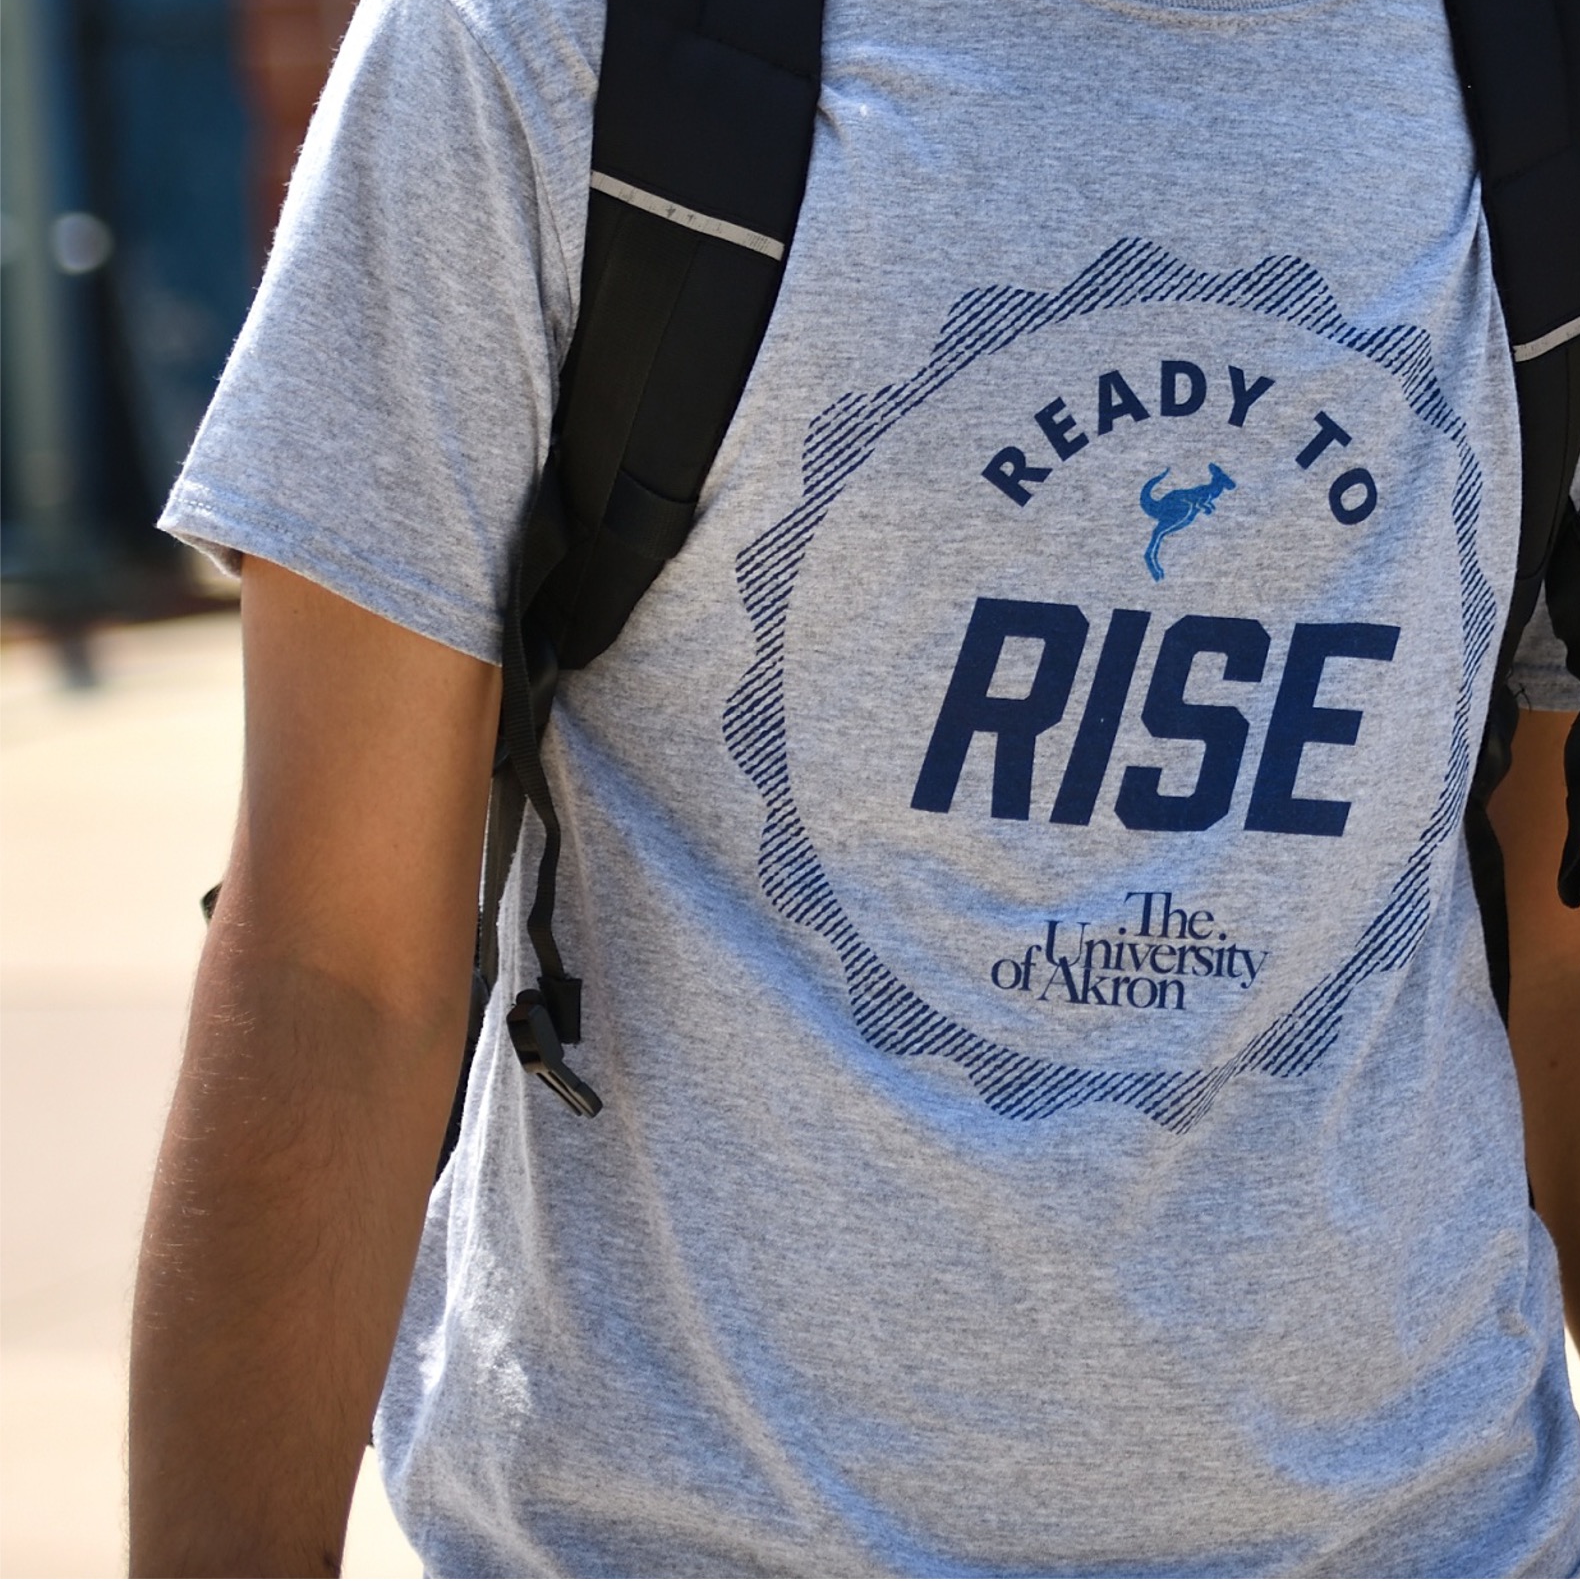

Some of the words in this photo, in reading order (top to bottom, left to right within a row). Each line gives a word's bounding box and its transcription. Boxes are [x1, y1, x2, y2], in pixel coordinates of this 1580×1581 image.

[981, 360, 1275, 507] READY
[1296, 411, 1378, 525] TO
[910, 596, 1401, 837] RISE
[1124, 891, 1215, 941] The
[990, 944, 1042, 992] of
[1038, 956, 1186, 1011] Akron
[1045, 919, 1272, 990] University
